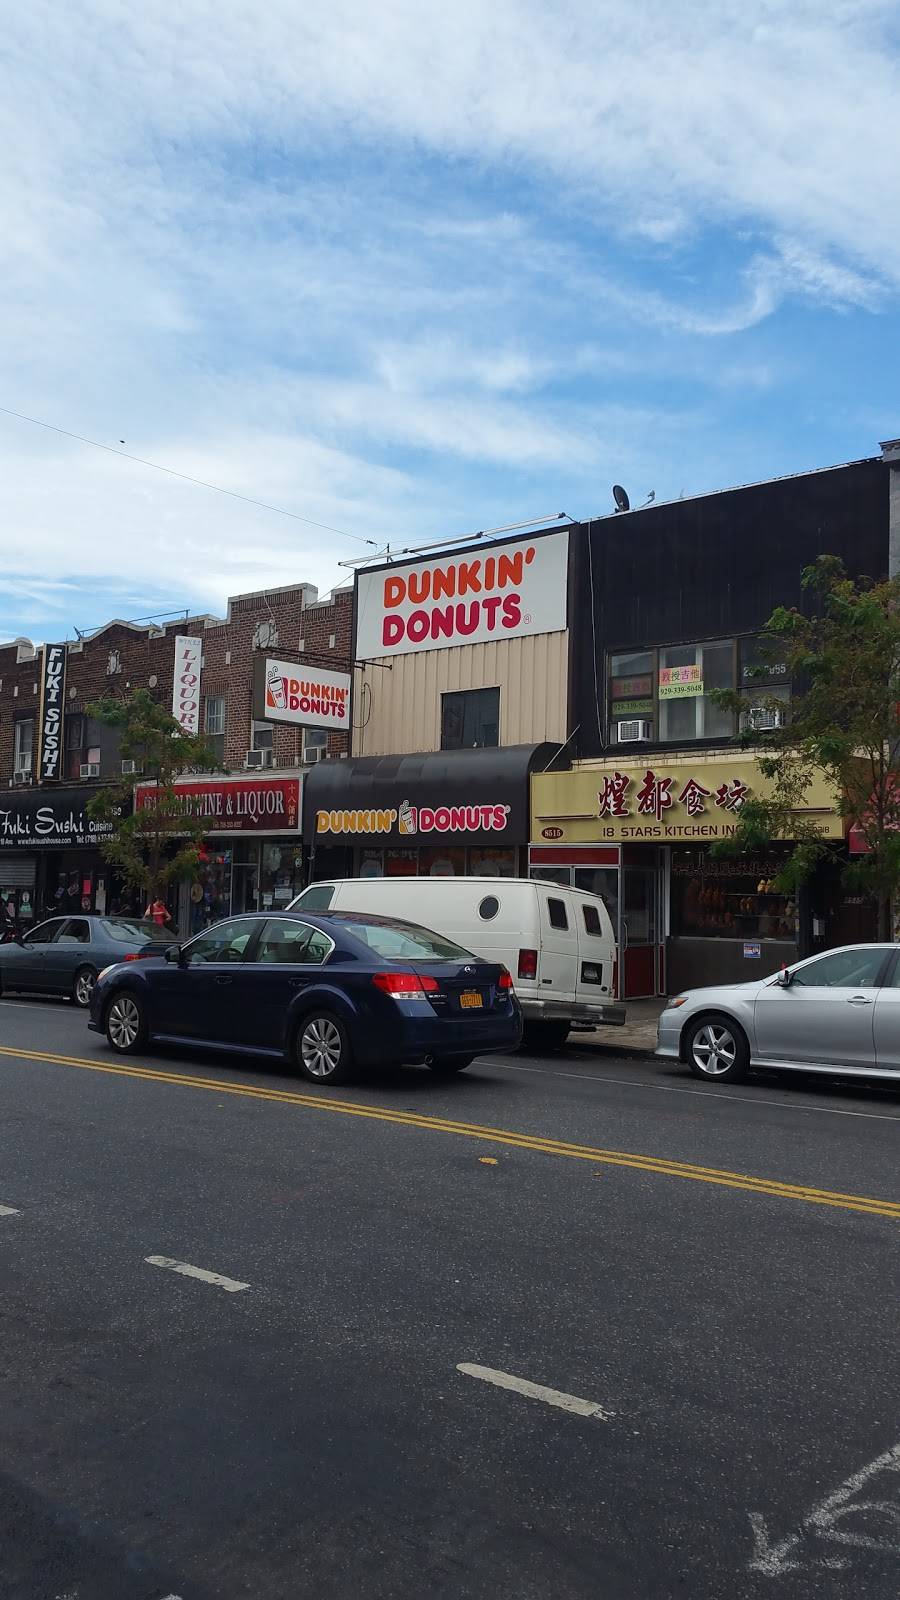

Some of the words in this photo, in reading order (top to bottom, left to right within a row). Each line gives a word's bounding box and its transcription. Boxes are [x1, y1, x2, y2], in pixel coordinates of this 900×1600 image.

[383, 547, 536, 608] DUNKIN'
[382, 593, 521, 646] DONUTS
[46, 648, 62, 702] FUKI
[289, 679, 349, 702] DUNKIN'
[660, 684, 702, 696] 929-339-5048
[289, 696, 345, 718] DONUTS
[43, 708, 60, 777] SUSHI
[198, 792, 222, 816] WINE
[226, 793, 234, 815] &
[236, 790, 285, 823] LIQUOR
[419, 804, 507, 832] DONUTS
[0, 811, 30, 834] Fuki
[35, 807, 84, 834] Sushi
[89, 820, 113, 832] Cuisine
[317, 809, 397, 834] DUNKIN'
[545, 829, 561, 837] 8515
[603, 827, 615, 837] 18
[621, 826, 661, 837] STARS
[665, 825, 718, 836] KITCHEN
